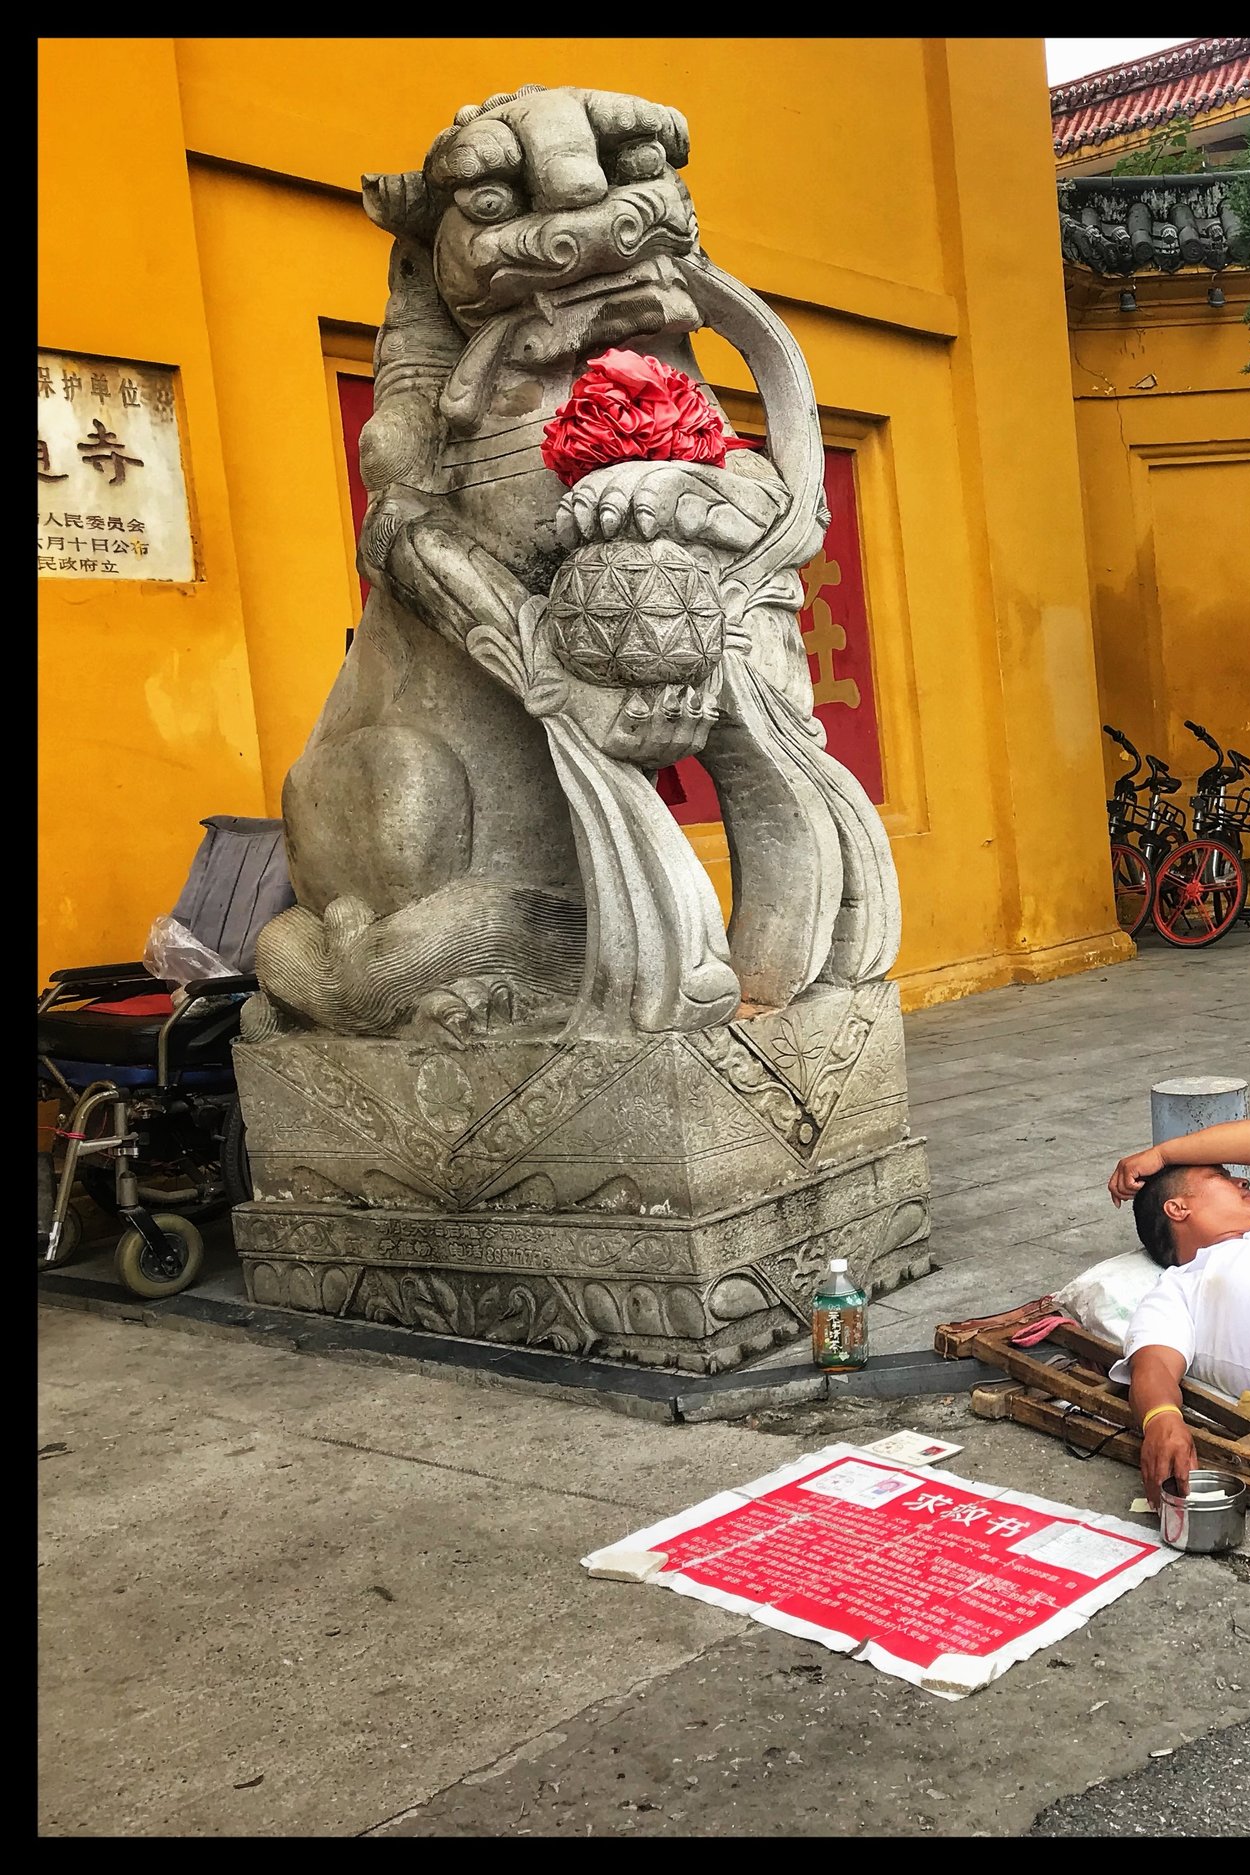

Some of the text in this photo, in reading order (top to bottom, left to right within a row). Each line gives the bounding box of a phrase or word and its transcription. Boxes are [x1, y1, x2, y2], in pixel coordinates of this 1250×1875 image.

[38, 366, 141, 408] 保护单位
[38, 512, 145, 533] 人民委员会
[902, 1492, 1032, 1538] 求救书
